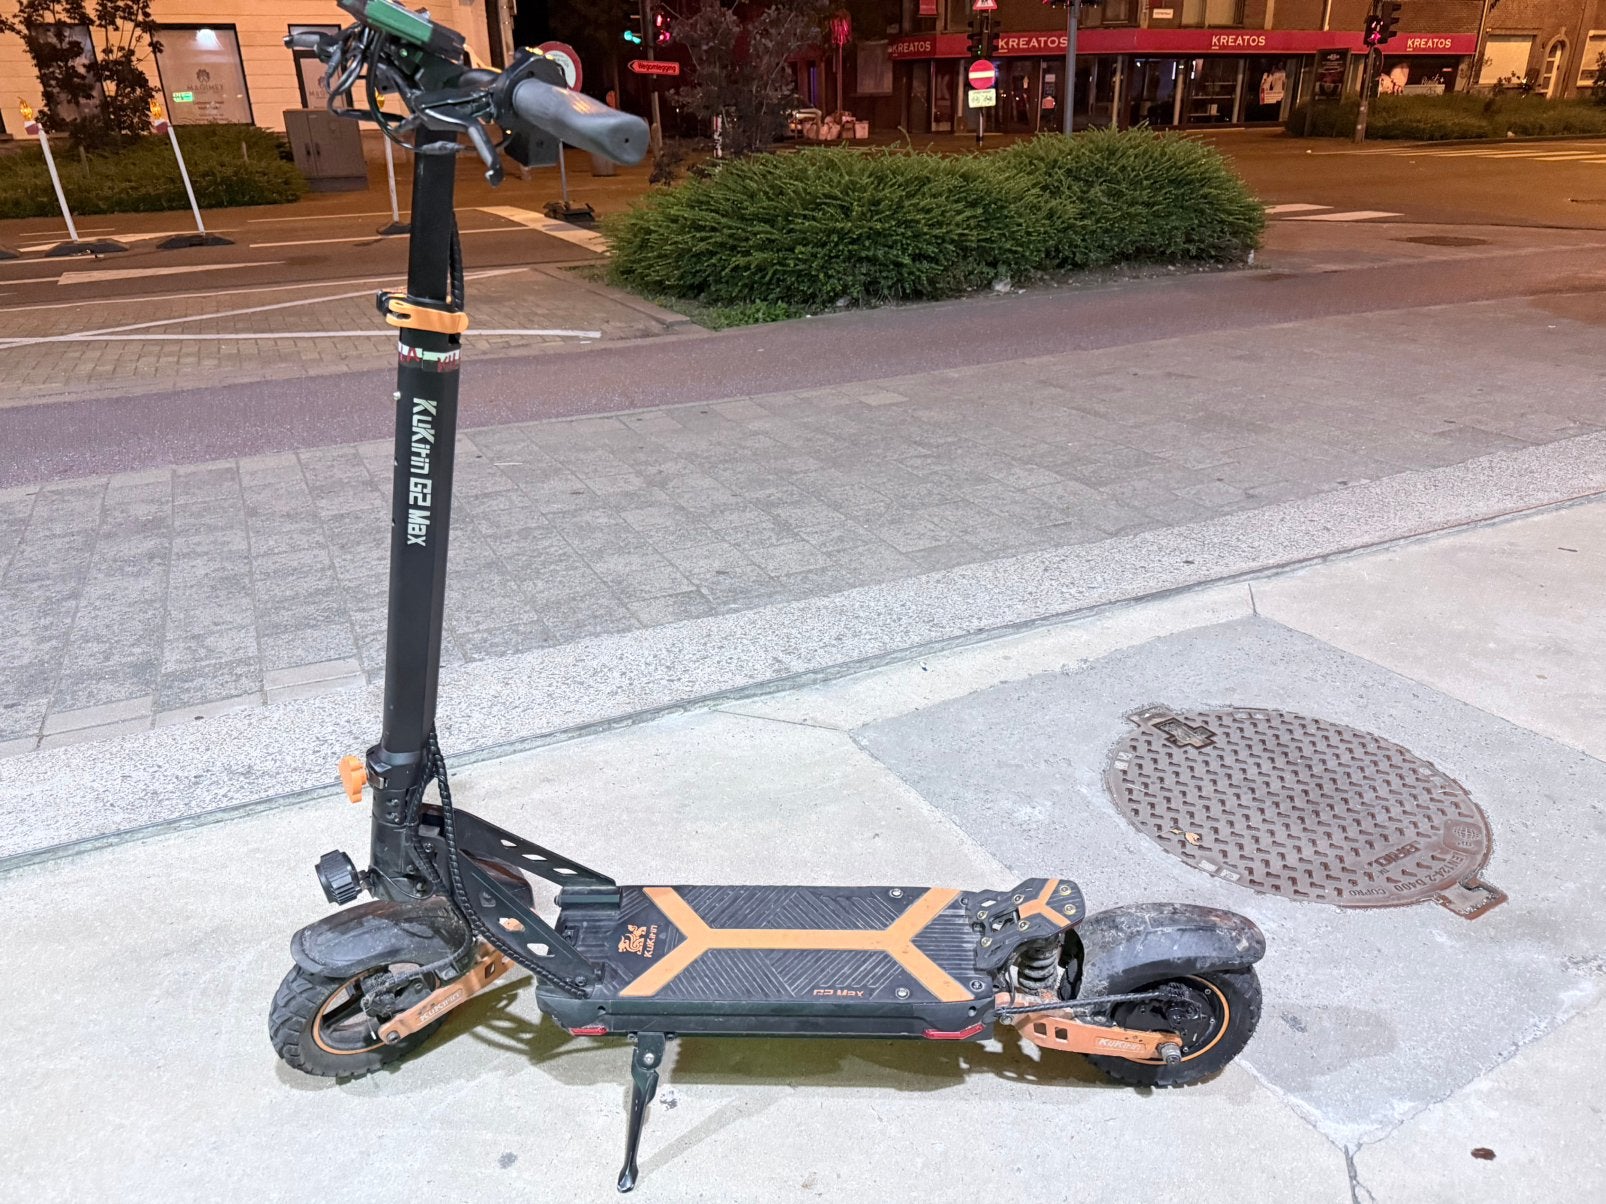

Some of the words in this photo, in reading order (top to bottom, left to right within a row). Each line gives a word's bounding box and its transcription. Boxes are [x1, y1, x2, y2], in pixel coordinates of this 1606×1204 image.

[892, 41, 931, 54] KREATOS
[999, 37, 1068, 50] KREATOS
[1211, 35, 1266, 47] KREATOS
[1407, 38, 1452, 49] KREATOS
[410, 397, 437, 475] KuKirin
[409, 476, 432, 507] G2
[407, 509, 431, 547] Max
[1394, 878, 1428, 892] D400
[643, 924, 658, 958] KuKirin
